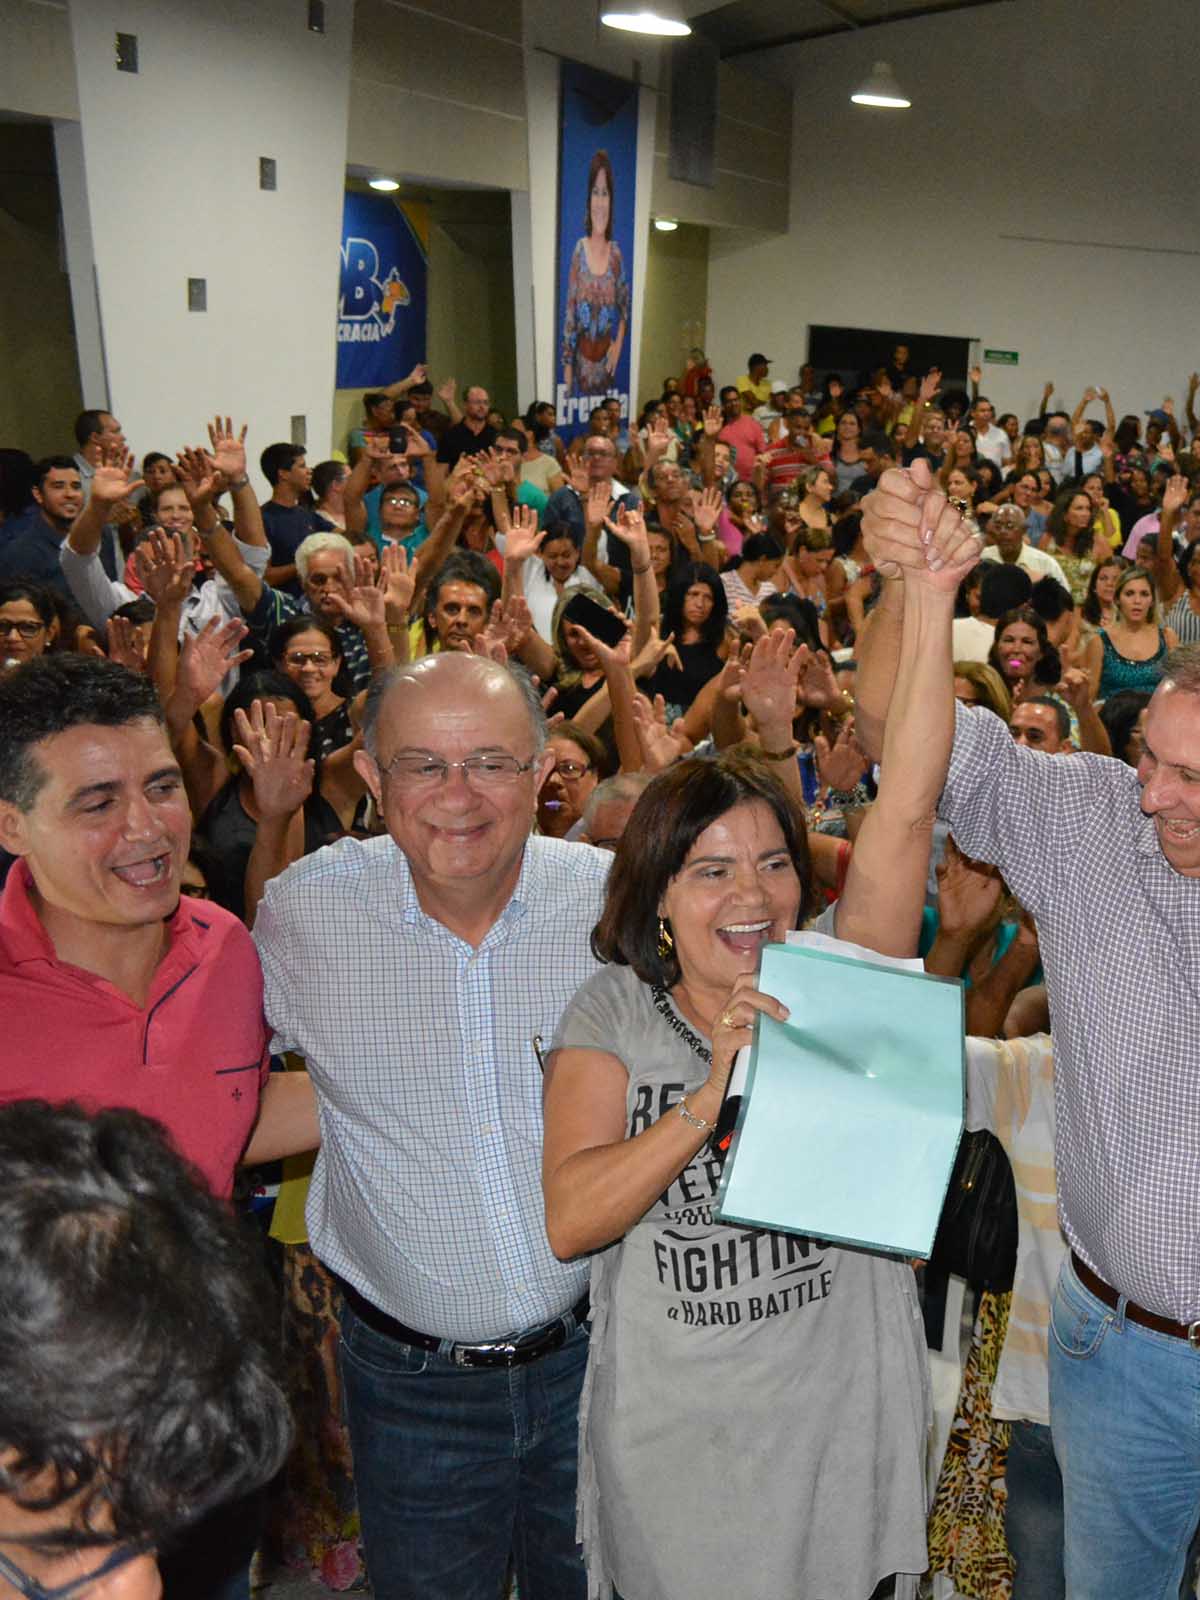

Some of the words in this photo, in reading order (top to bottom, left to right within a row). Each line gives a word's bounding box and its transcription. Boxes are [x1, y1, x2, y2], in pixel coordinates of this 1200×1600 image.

[653, 1231, 832, 1293] FIGHTIN
[667, 1308, 679, 1321] a
[680, 1299, 741, 1327] HARD
[748, 1269, 833, 1322] BATTLE
